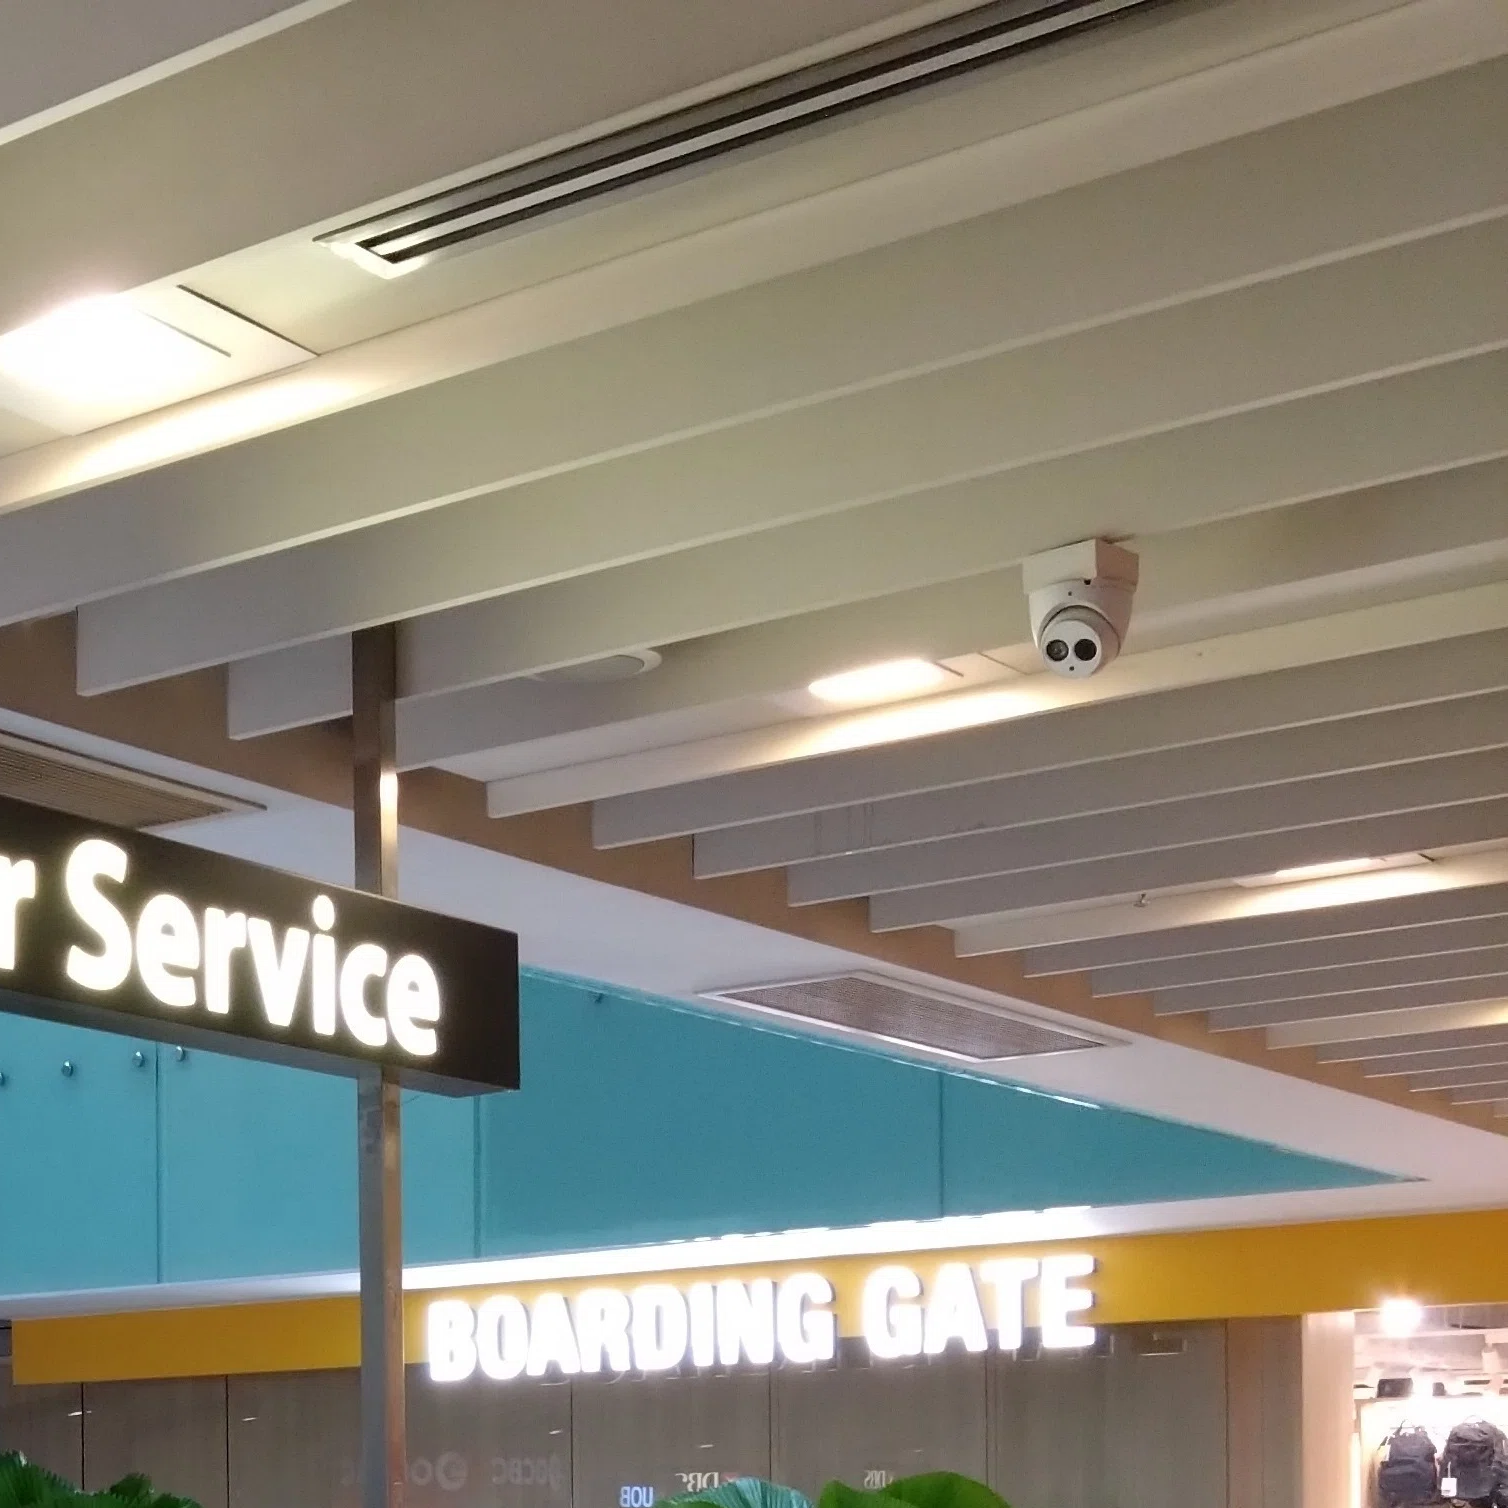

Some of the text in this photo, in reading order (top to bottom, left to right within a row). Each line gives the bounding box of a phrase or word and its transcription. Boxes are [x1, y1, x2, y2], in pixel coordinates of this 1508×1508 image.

[64, 838, 442, 1056] Service
[428, 1253, 1096, 1382] BOARDING GATE
